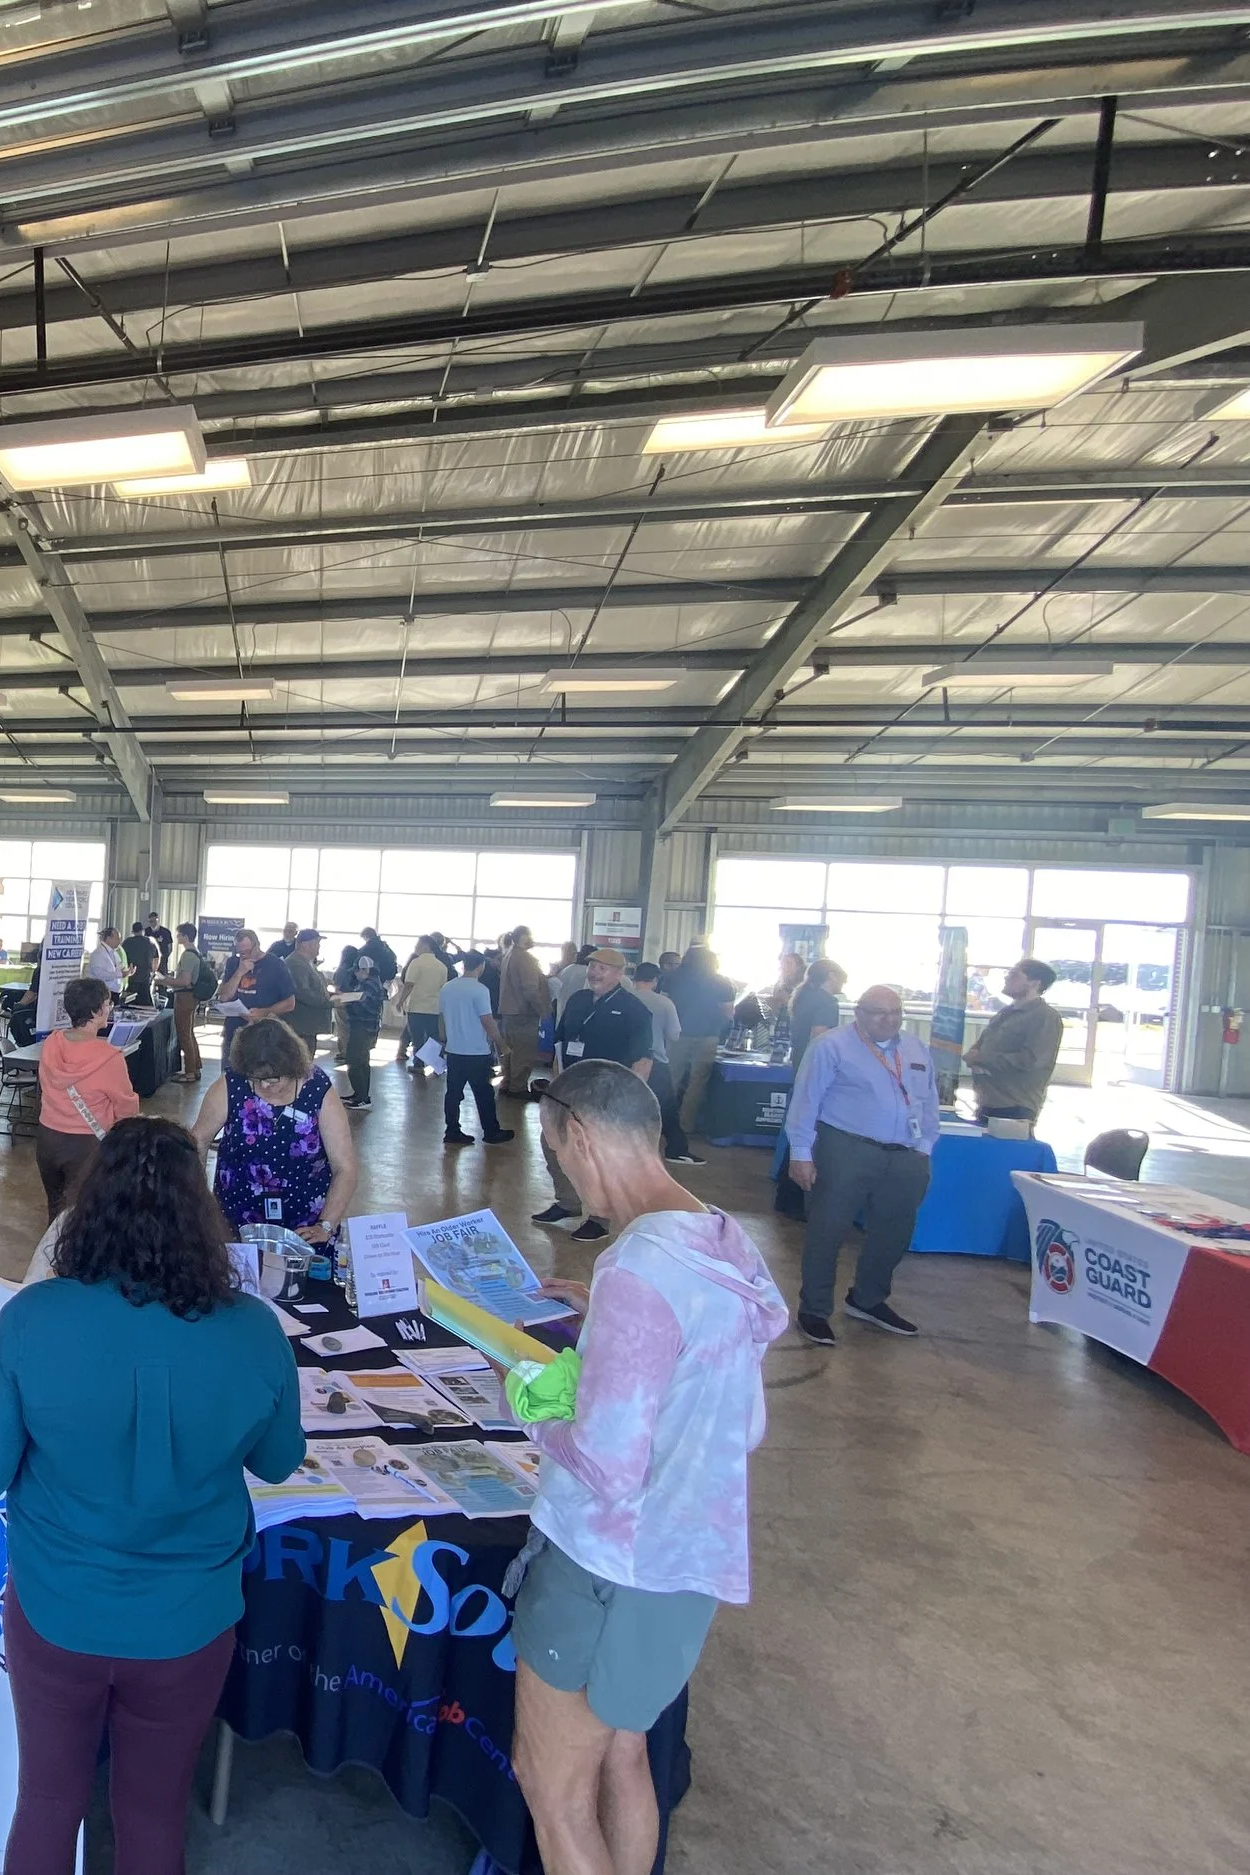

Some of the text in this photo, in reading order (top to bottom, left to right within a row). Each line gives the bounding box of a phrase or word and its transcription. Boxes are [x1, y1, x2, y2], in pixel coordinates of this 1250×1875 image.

[52, 920, 66, 930] NEED
[203, 933, 235, 942] Now Hirin
[48, 949, 61, 959] NEW
[440, 1224, 459, 1232] Older
[458, 1217, 484, 1228] Worker
[431, 1225, 480, 1244] JOB FAIR
[1084, 1247, 1151, 1289] COAST
[1085, 1266, 1152, 1309] GUARD
[310, 1663, 341, 1692] he
